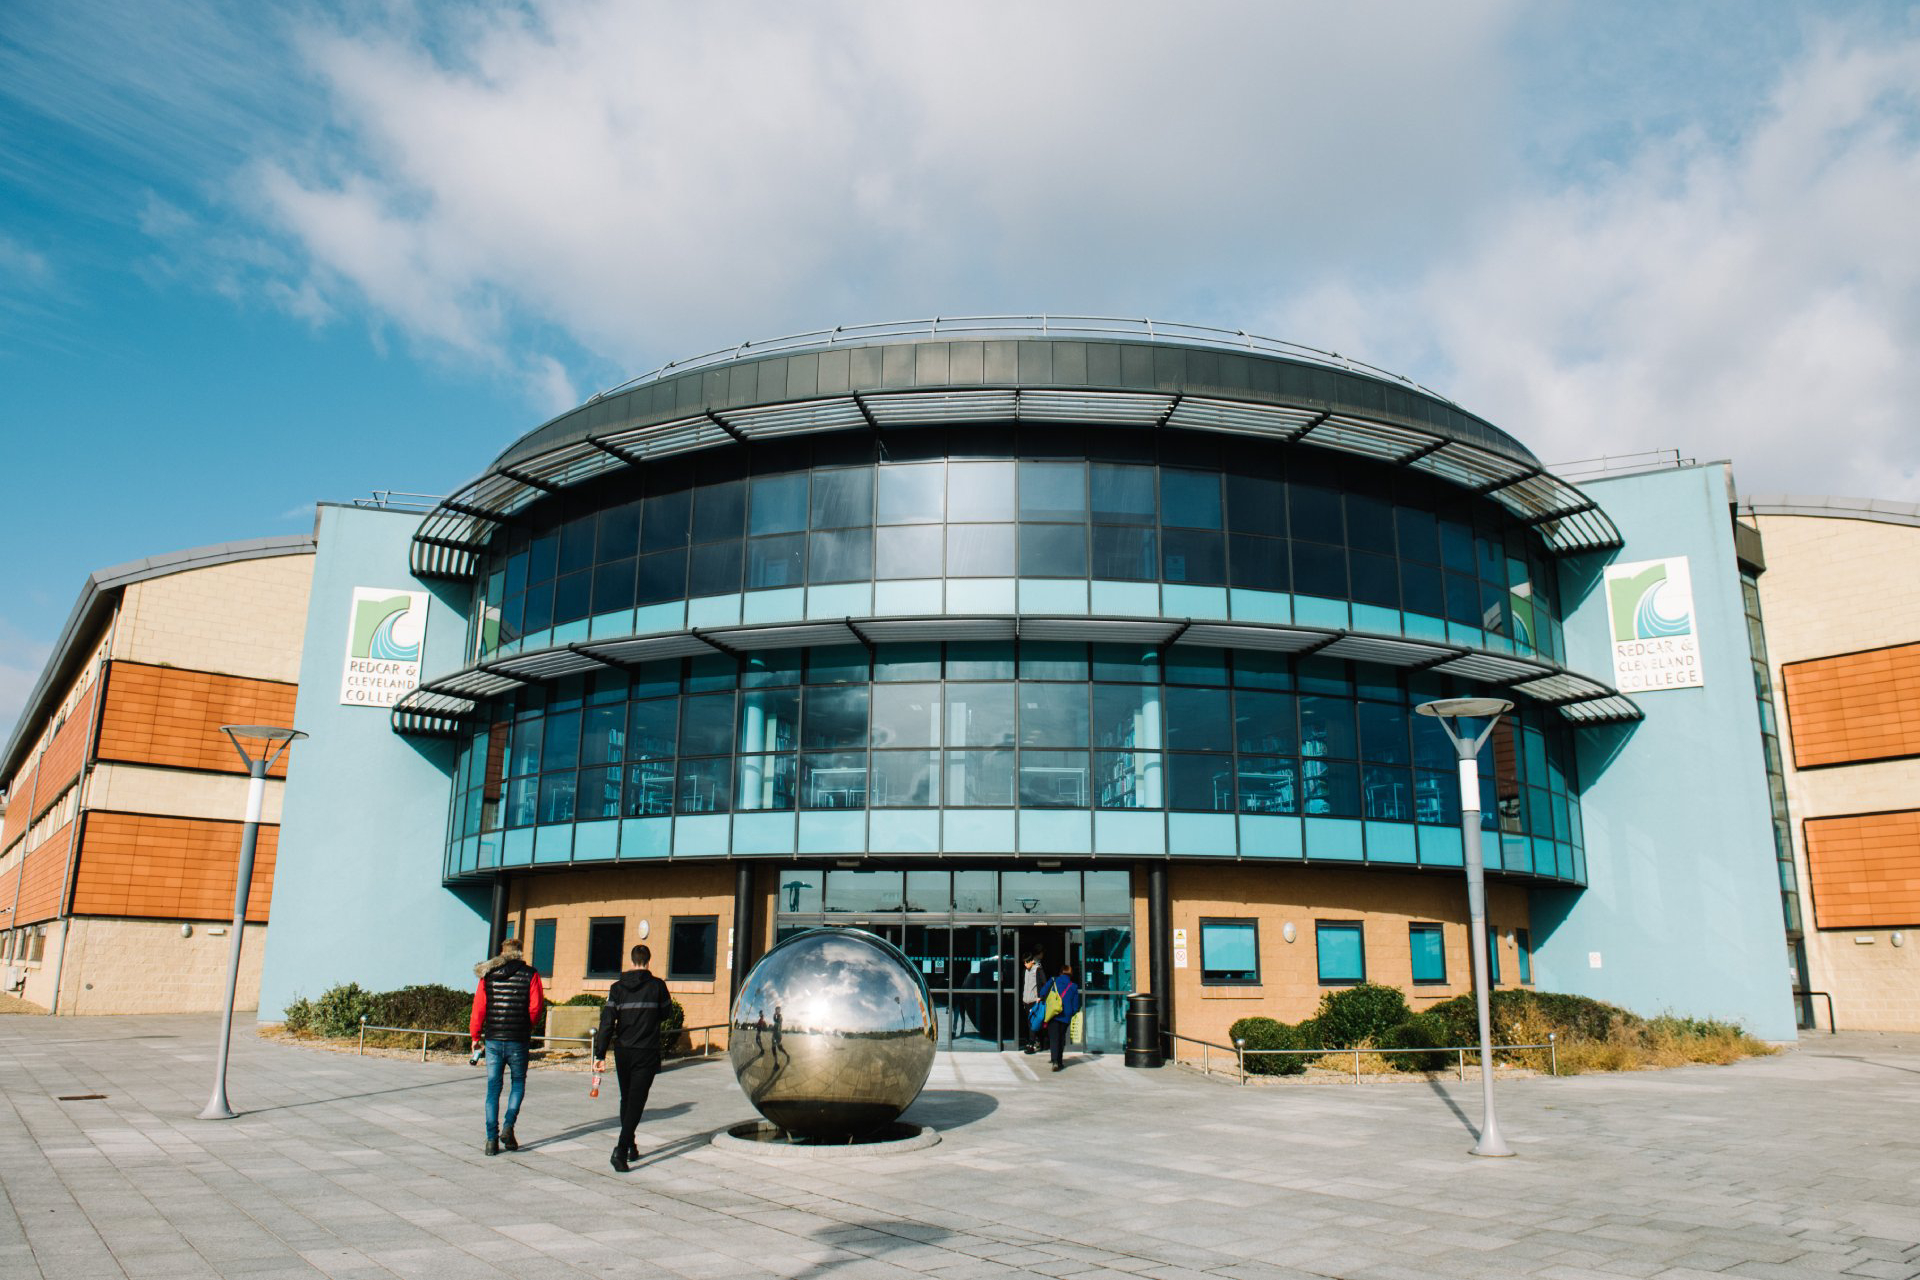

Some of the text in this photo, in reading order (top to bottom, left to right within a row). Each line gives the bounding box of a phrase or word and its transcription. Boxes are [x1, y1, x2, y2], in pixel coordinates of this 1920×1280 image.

[1617, 639, 1694, 656] REDCAR &
[350, 660, 417, 676] REDCAR &
[1618, 656, 1695, 672] CLEVELAND
[347, 676, 415, 689] CLEVELAND
[1621, 670, 1697, 688] COLLEGE
